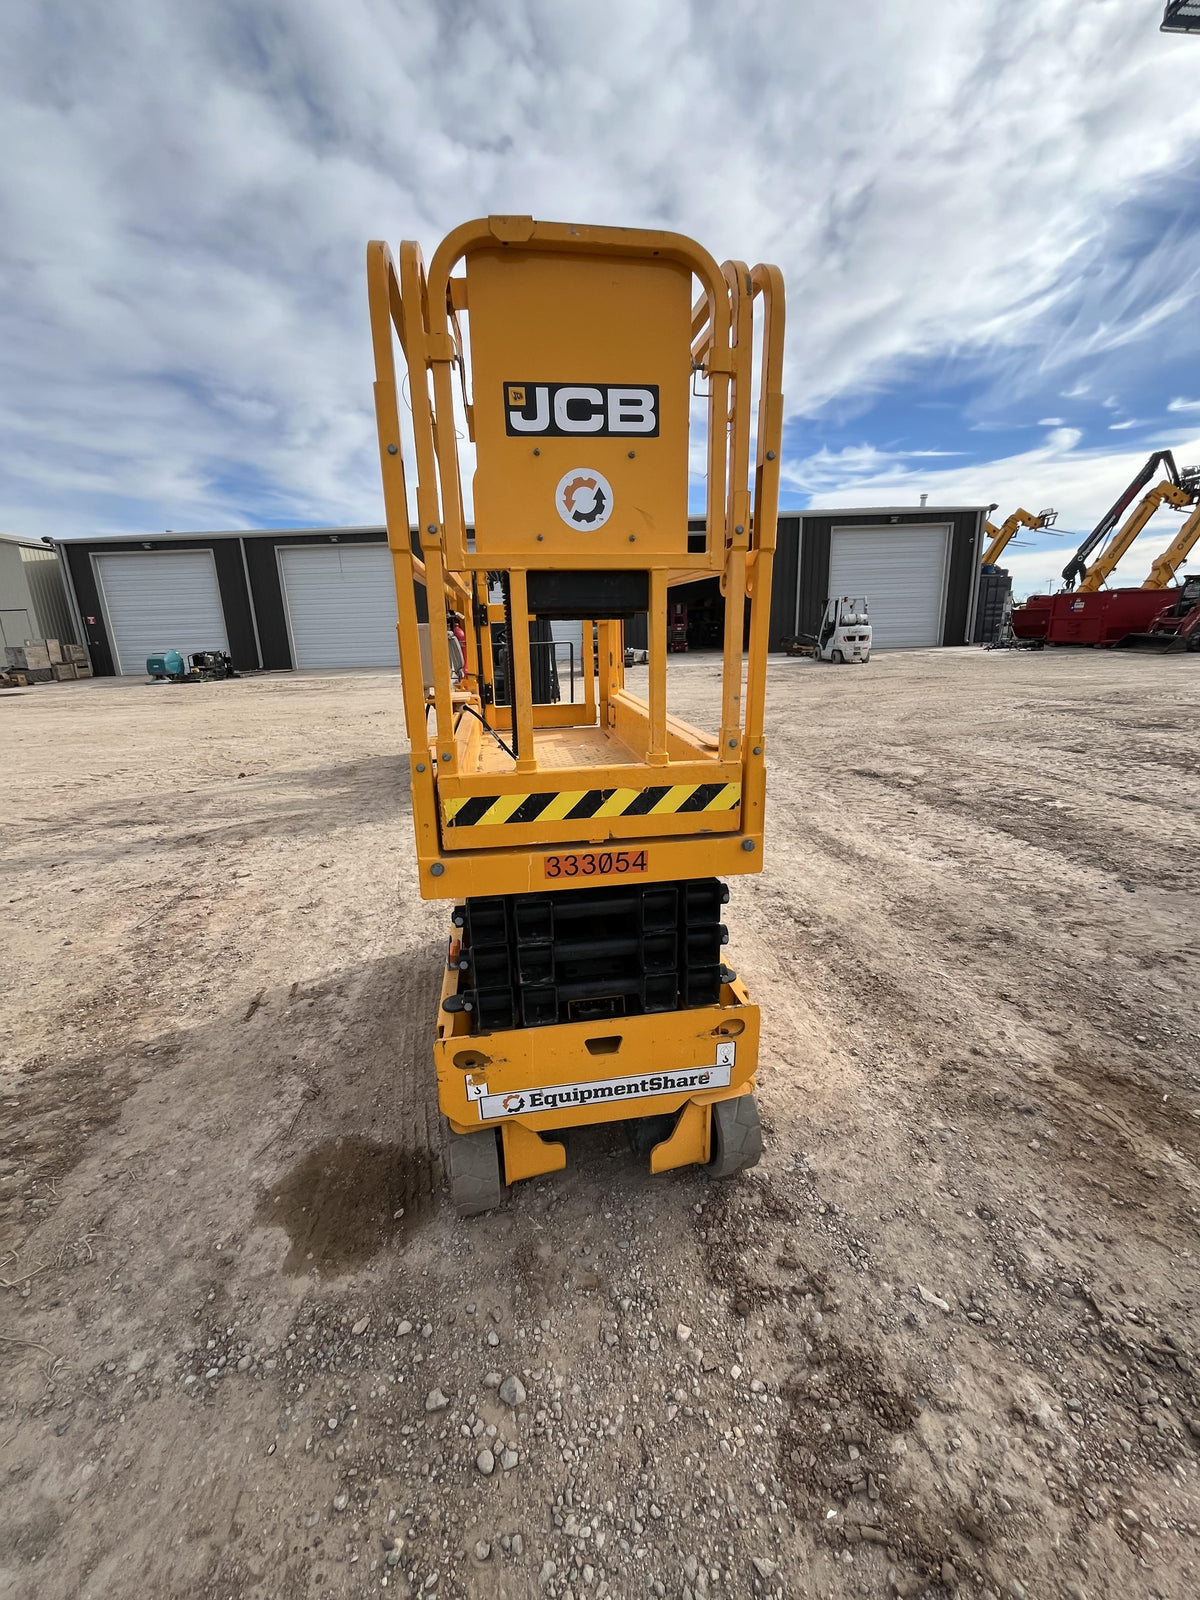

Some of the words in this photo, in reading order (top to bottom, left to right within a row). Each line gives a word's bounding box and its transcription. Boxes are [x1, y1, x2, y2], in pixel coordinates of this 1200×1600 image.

[509, 386, 656, 432] JCB
[546, 850, 647, 877] 333054
[529, 1073, 710, 1107] EquipmentShare
